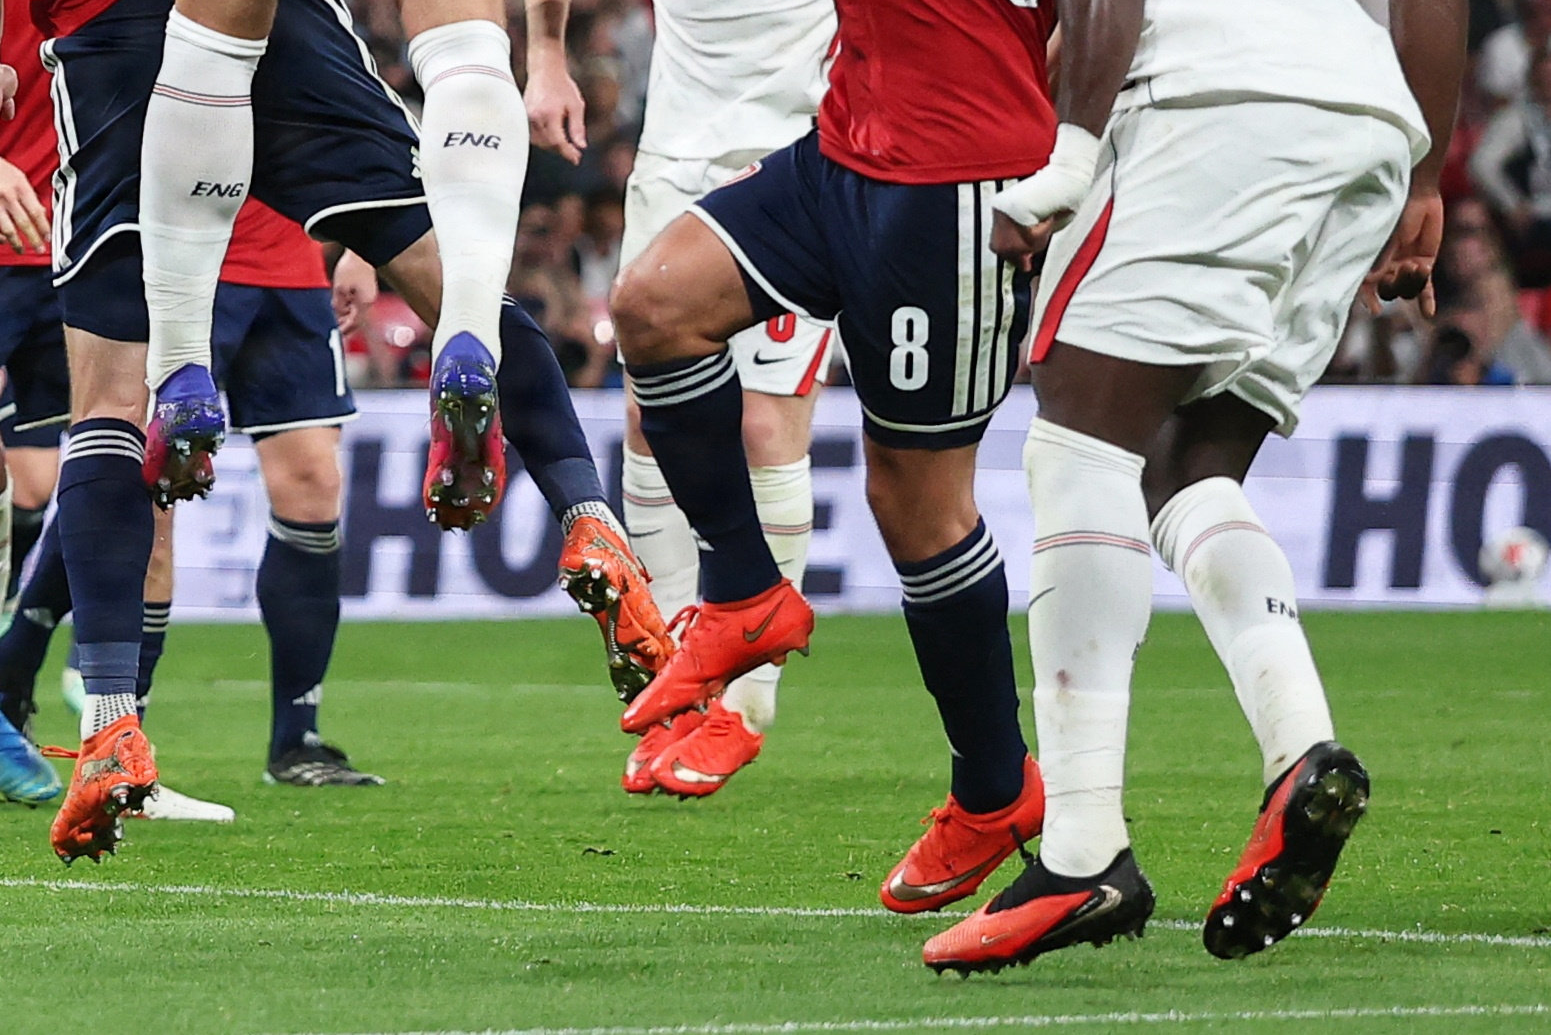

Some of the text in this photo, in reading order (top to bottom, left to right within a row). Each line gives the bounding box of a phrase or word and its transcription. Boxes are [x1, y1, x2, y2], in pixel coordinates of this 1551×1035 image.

[444, 132, 501, 149] ENG
[191, 181, 245, 198] ENG
[889, 306, 930, 391] 8
[1266, 597, 1300, 621] EN
